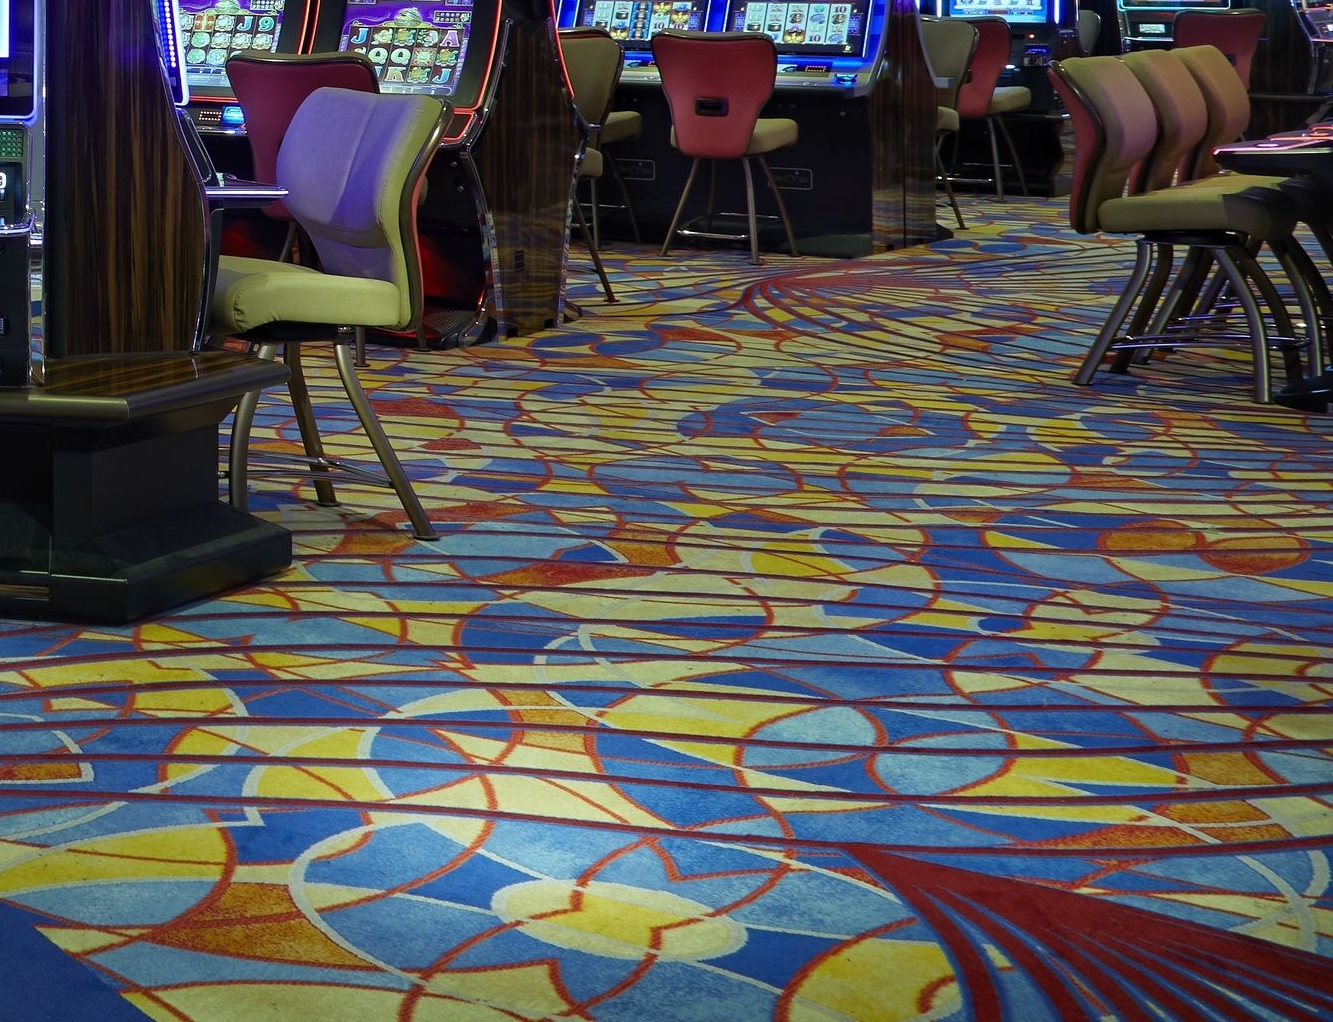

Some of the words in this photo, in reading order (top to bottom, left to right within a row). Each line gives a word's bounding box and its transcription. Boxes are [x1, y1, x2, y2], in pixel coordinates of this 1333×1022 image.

[236, 16, 253, 31] J
[258, 17, 275, 31] 9
[351, 28, 369, 44] J
[440, 30, 460, 47] A
[368, 47, 388, 64] Q
[391, 47, 411, 65] Q
[384, 66, 406, 83] K
[432, 68, 452, 84] J
